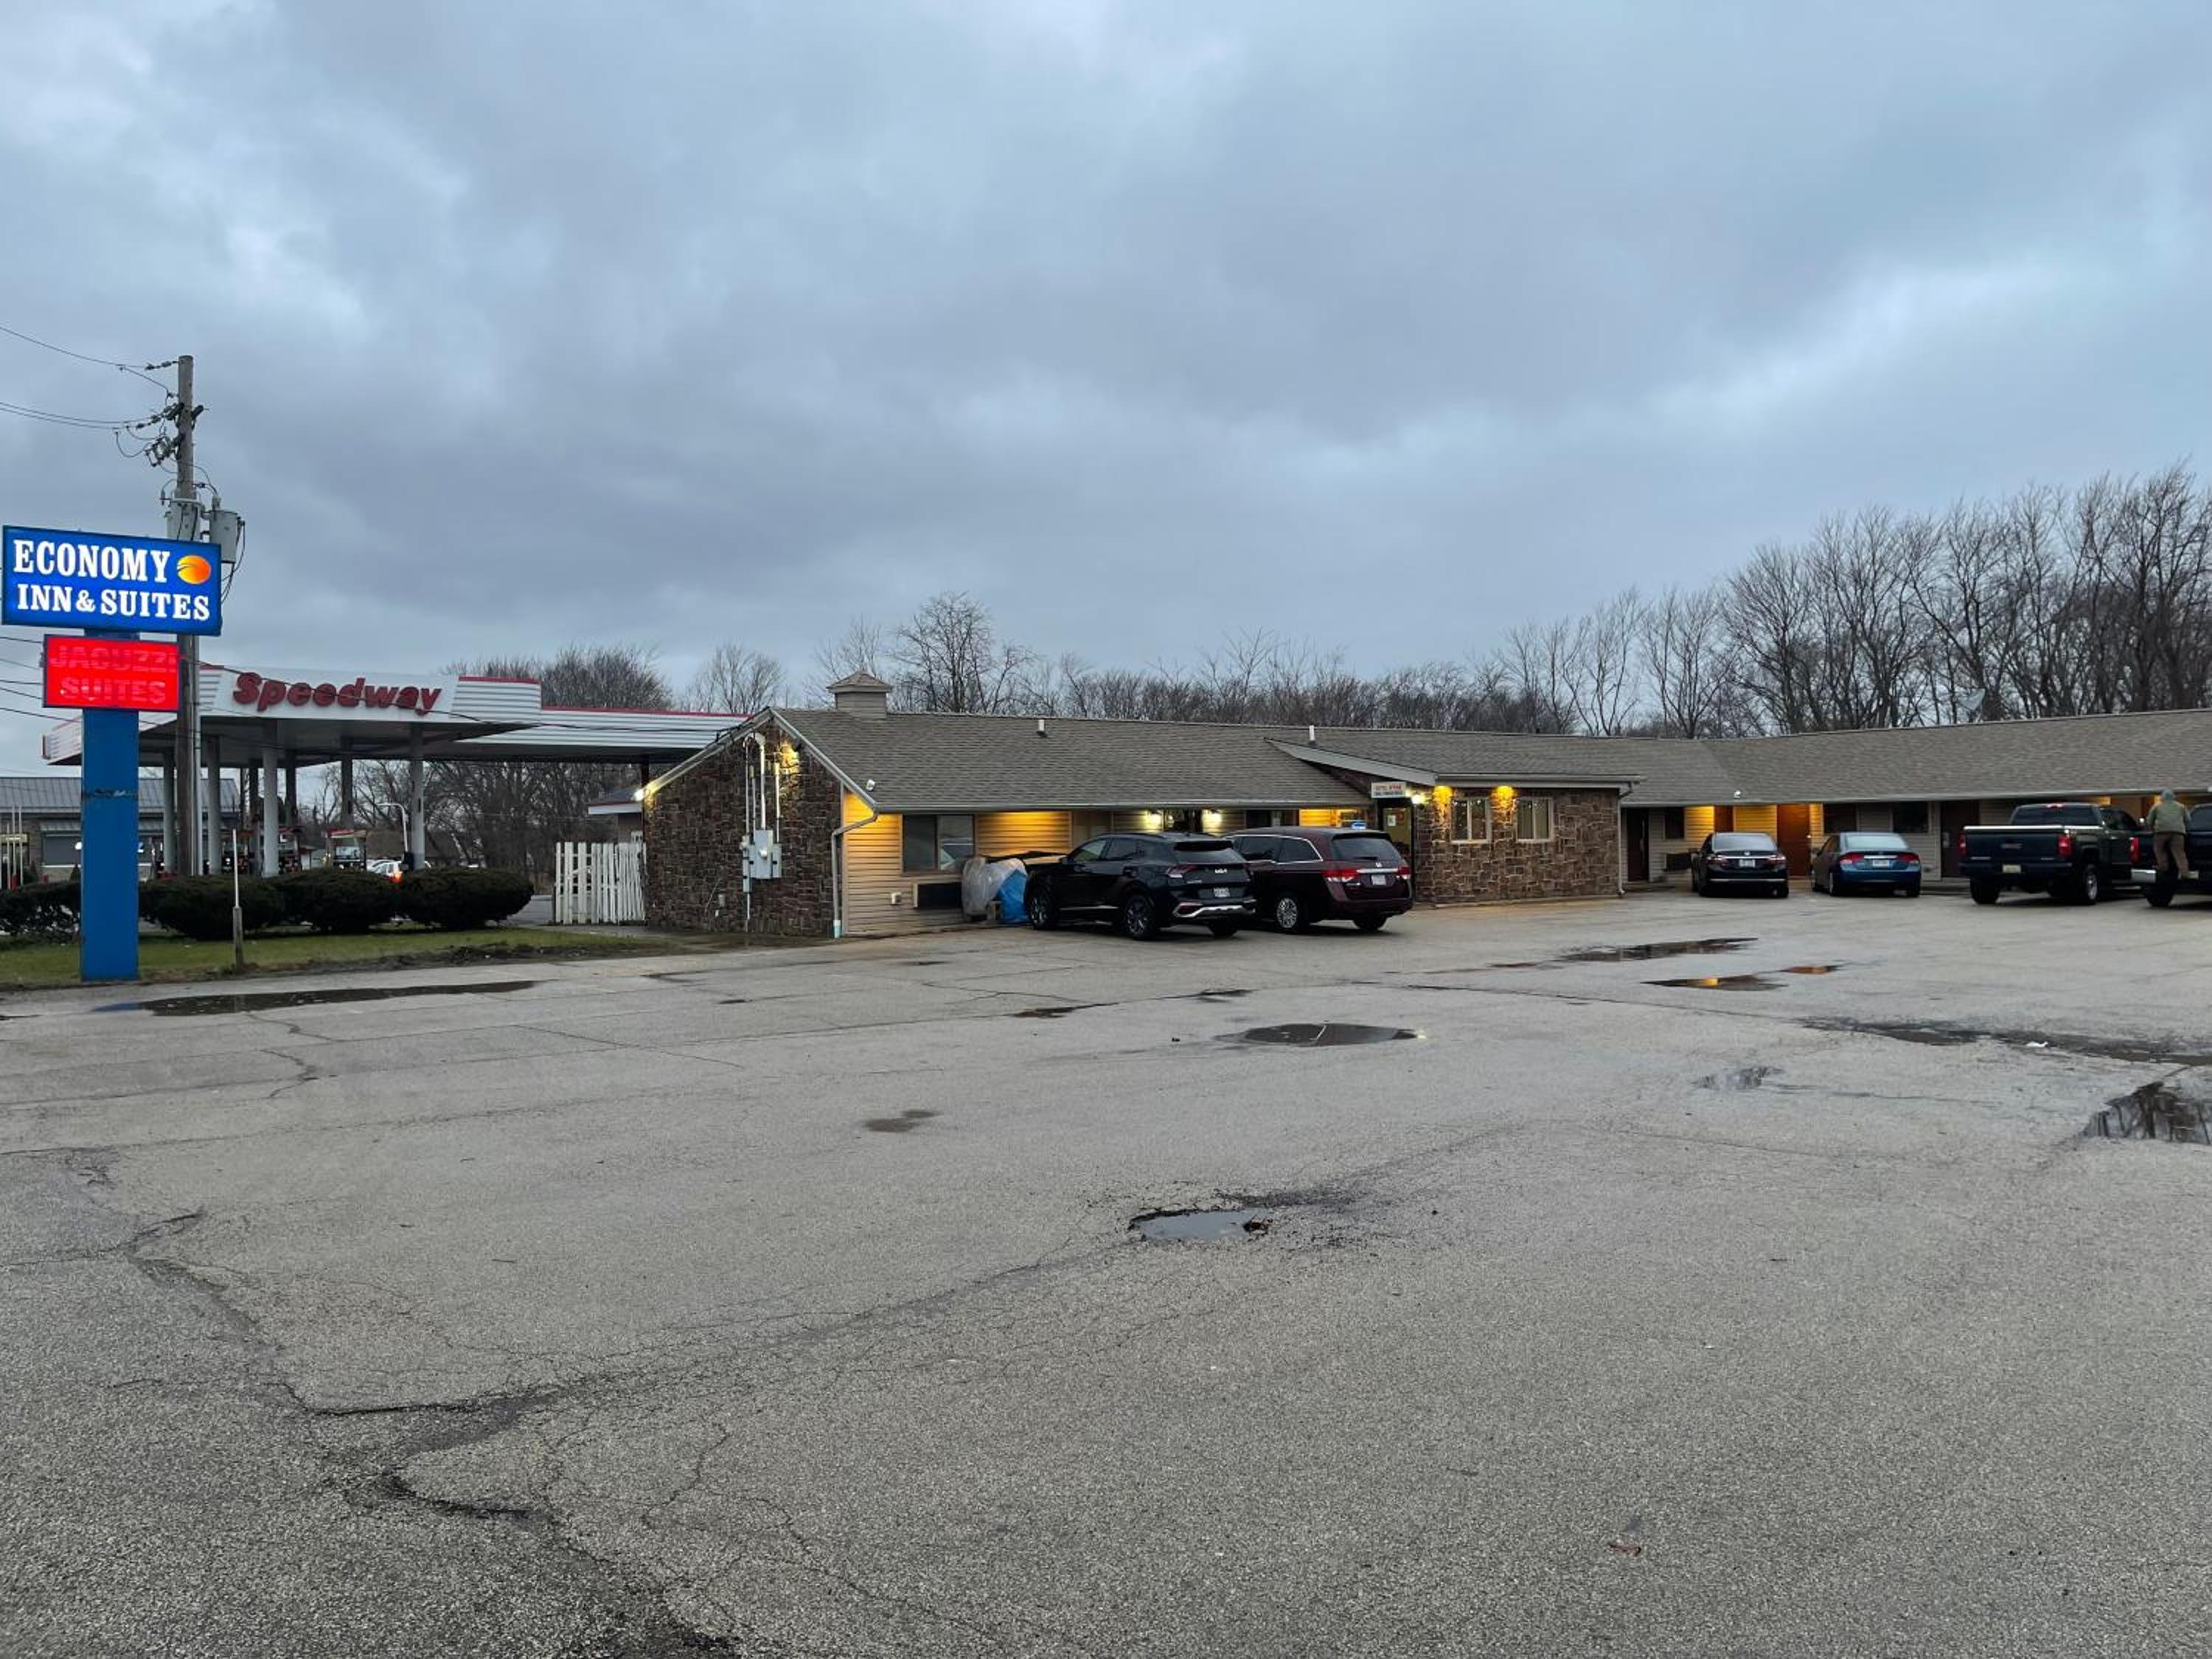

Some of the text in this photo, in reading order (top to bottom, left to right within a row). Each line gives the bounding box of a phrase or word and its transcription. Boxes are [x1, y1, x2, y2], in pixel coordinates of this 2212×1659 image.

[13, 539, 170, 582] ECONOMY
[17, 583, 210, 621] INN & SUITES
[59, 676, 166, 704] SUITES
[232, 672, 442, 716] Speedway
